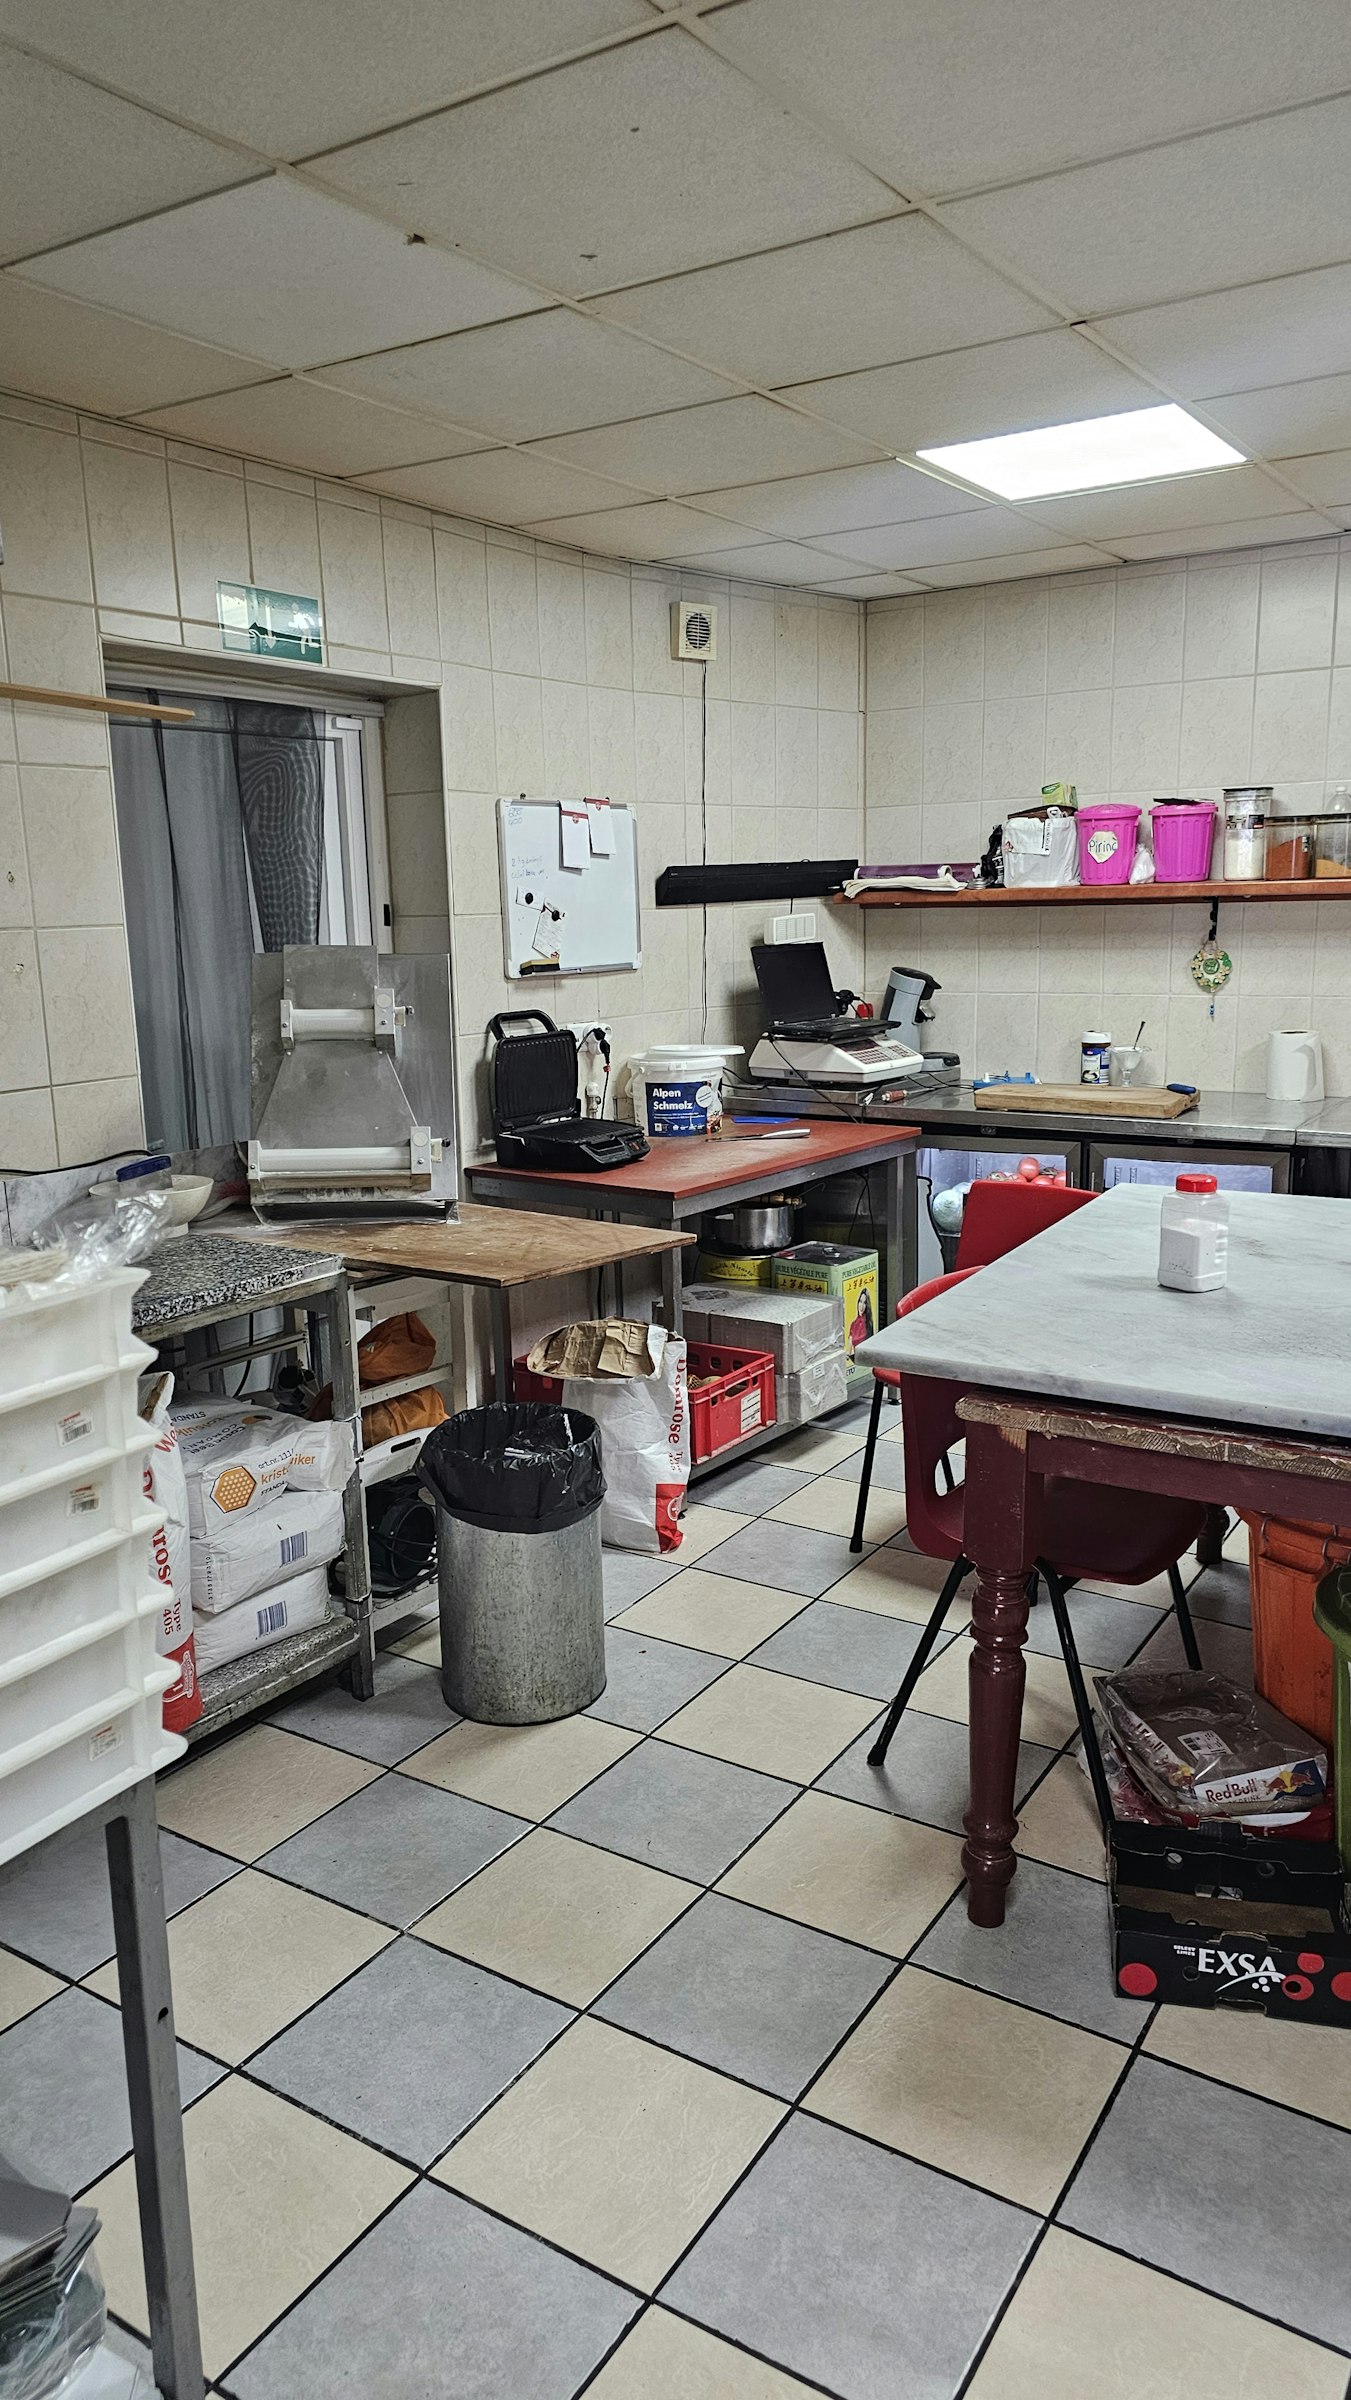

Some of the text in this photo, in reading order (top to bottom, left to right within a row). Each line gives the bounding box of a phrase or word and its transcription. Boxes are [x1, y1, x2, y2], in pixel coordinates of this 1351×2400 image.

[652, 1088, 681, 1099] Alpen
[653, 1100, 693, 1111] Schmelz
[162, 1608, 174, 1636] 405
[172, 1598, 182, 1632] Type
[1198, 1947, 1282, 1983] EXSA
